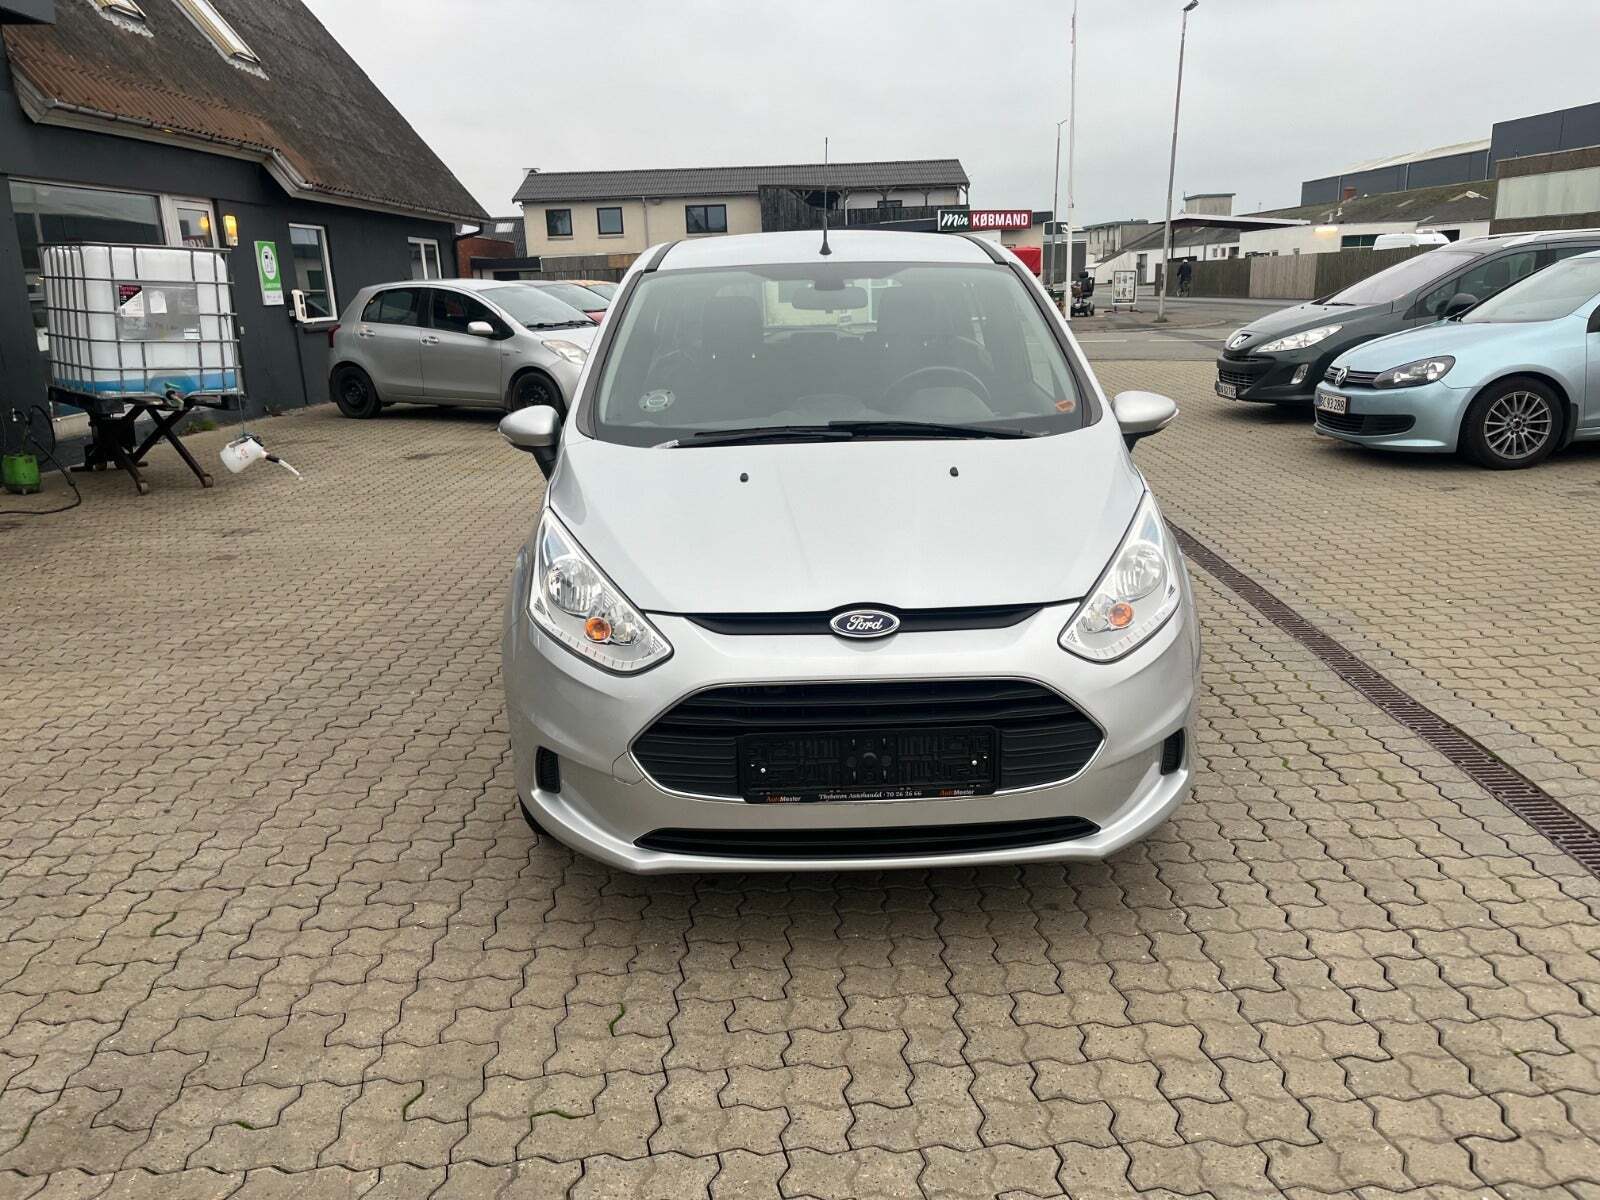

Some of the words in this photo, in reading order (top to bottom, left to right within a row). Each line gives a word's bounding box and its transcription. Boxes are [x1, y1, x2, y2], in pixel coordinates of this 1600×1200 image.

[941, 213, 969, 227] Min
[972, 213, 1028, 227] KØBMAND
[846, 614, 884, 631] Ford
